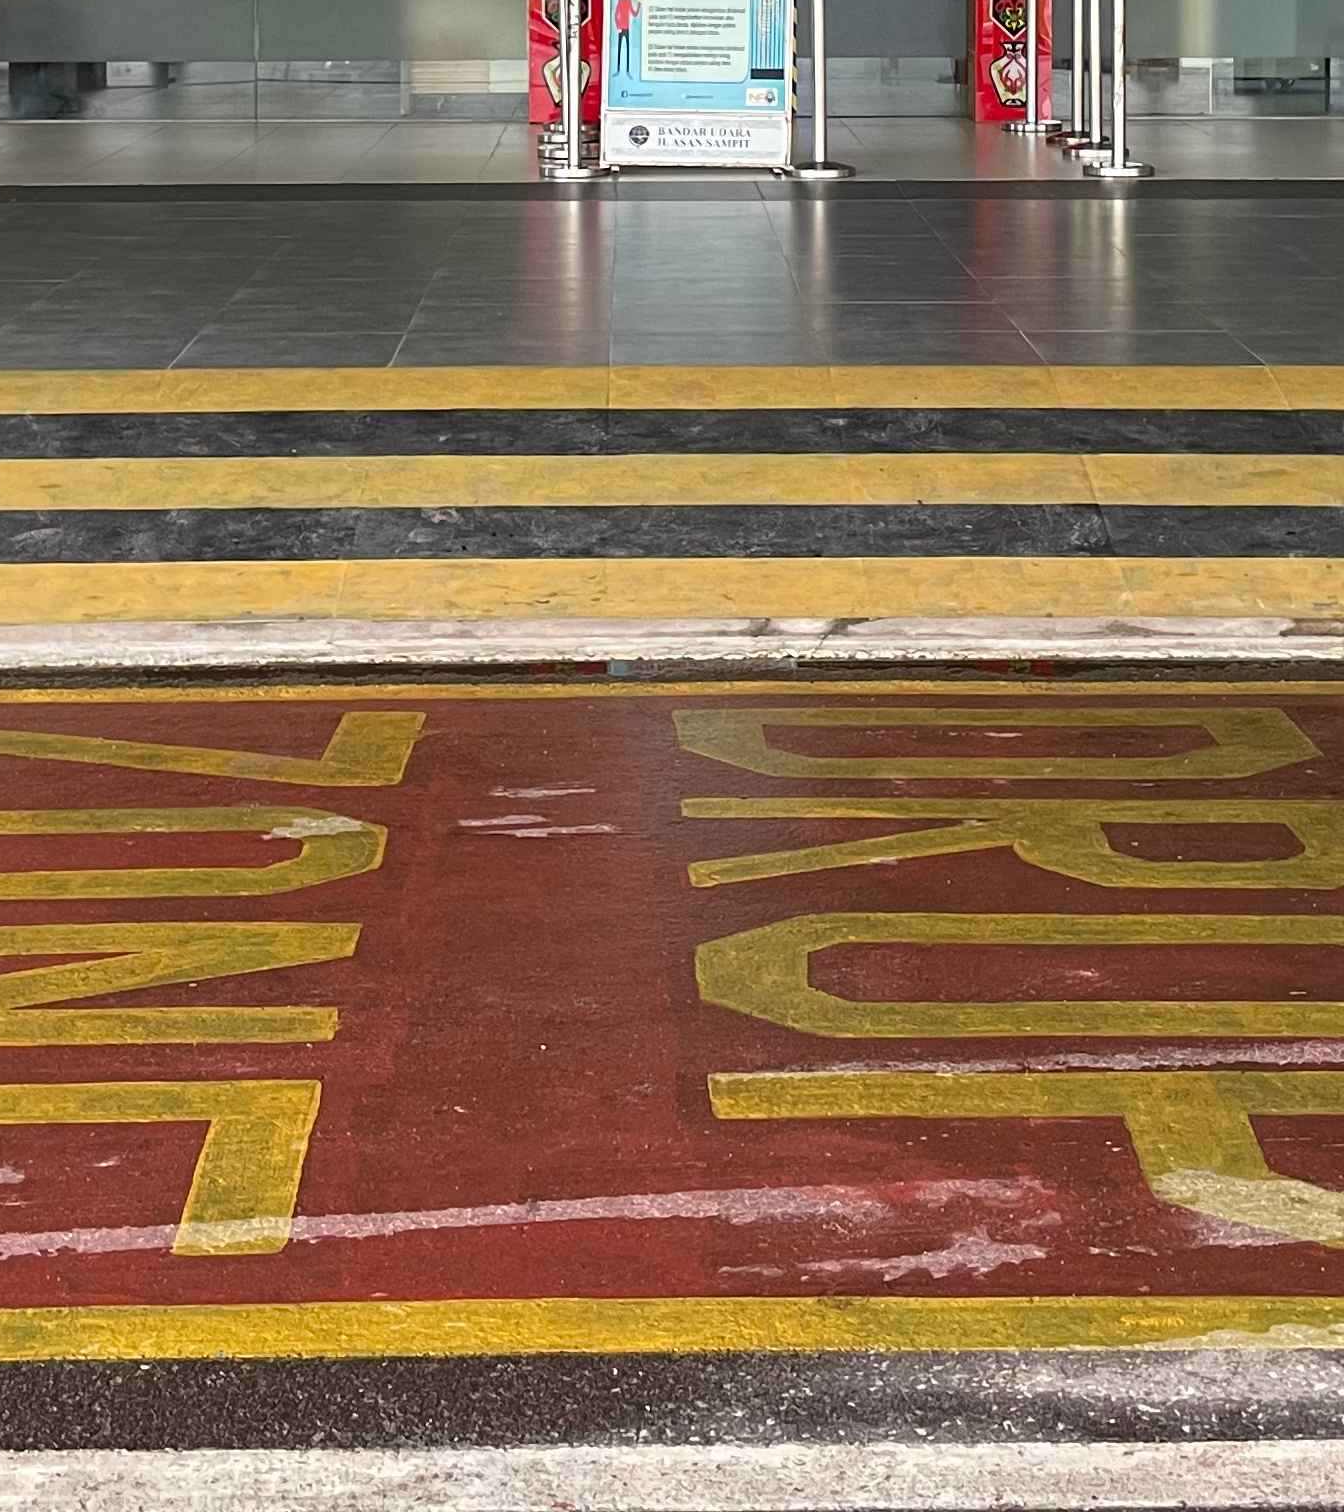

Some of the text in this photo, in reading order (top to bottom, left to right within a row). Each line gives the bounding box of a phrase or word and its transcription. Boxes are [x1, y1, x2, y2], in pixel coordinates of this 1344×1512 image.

[658, 127, 751, 138] BANDAR UDARA
[706, 139, 752, 149] SAMPIT
